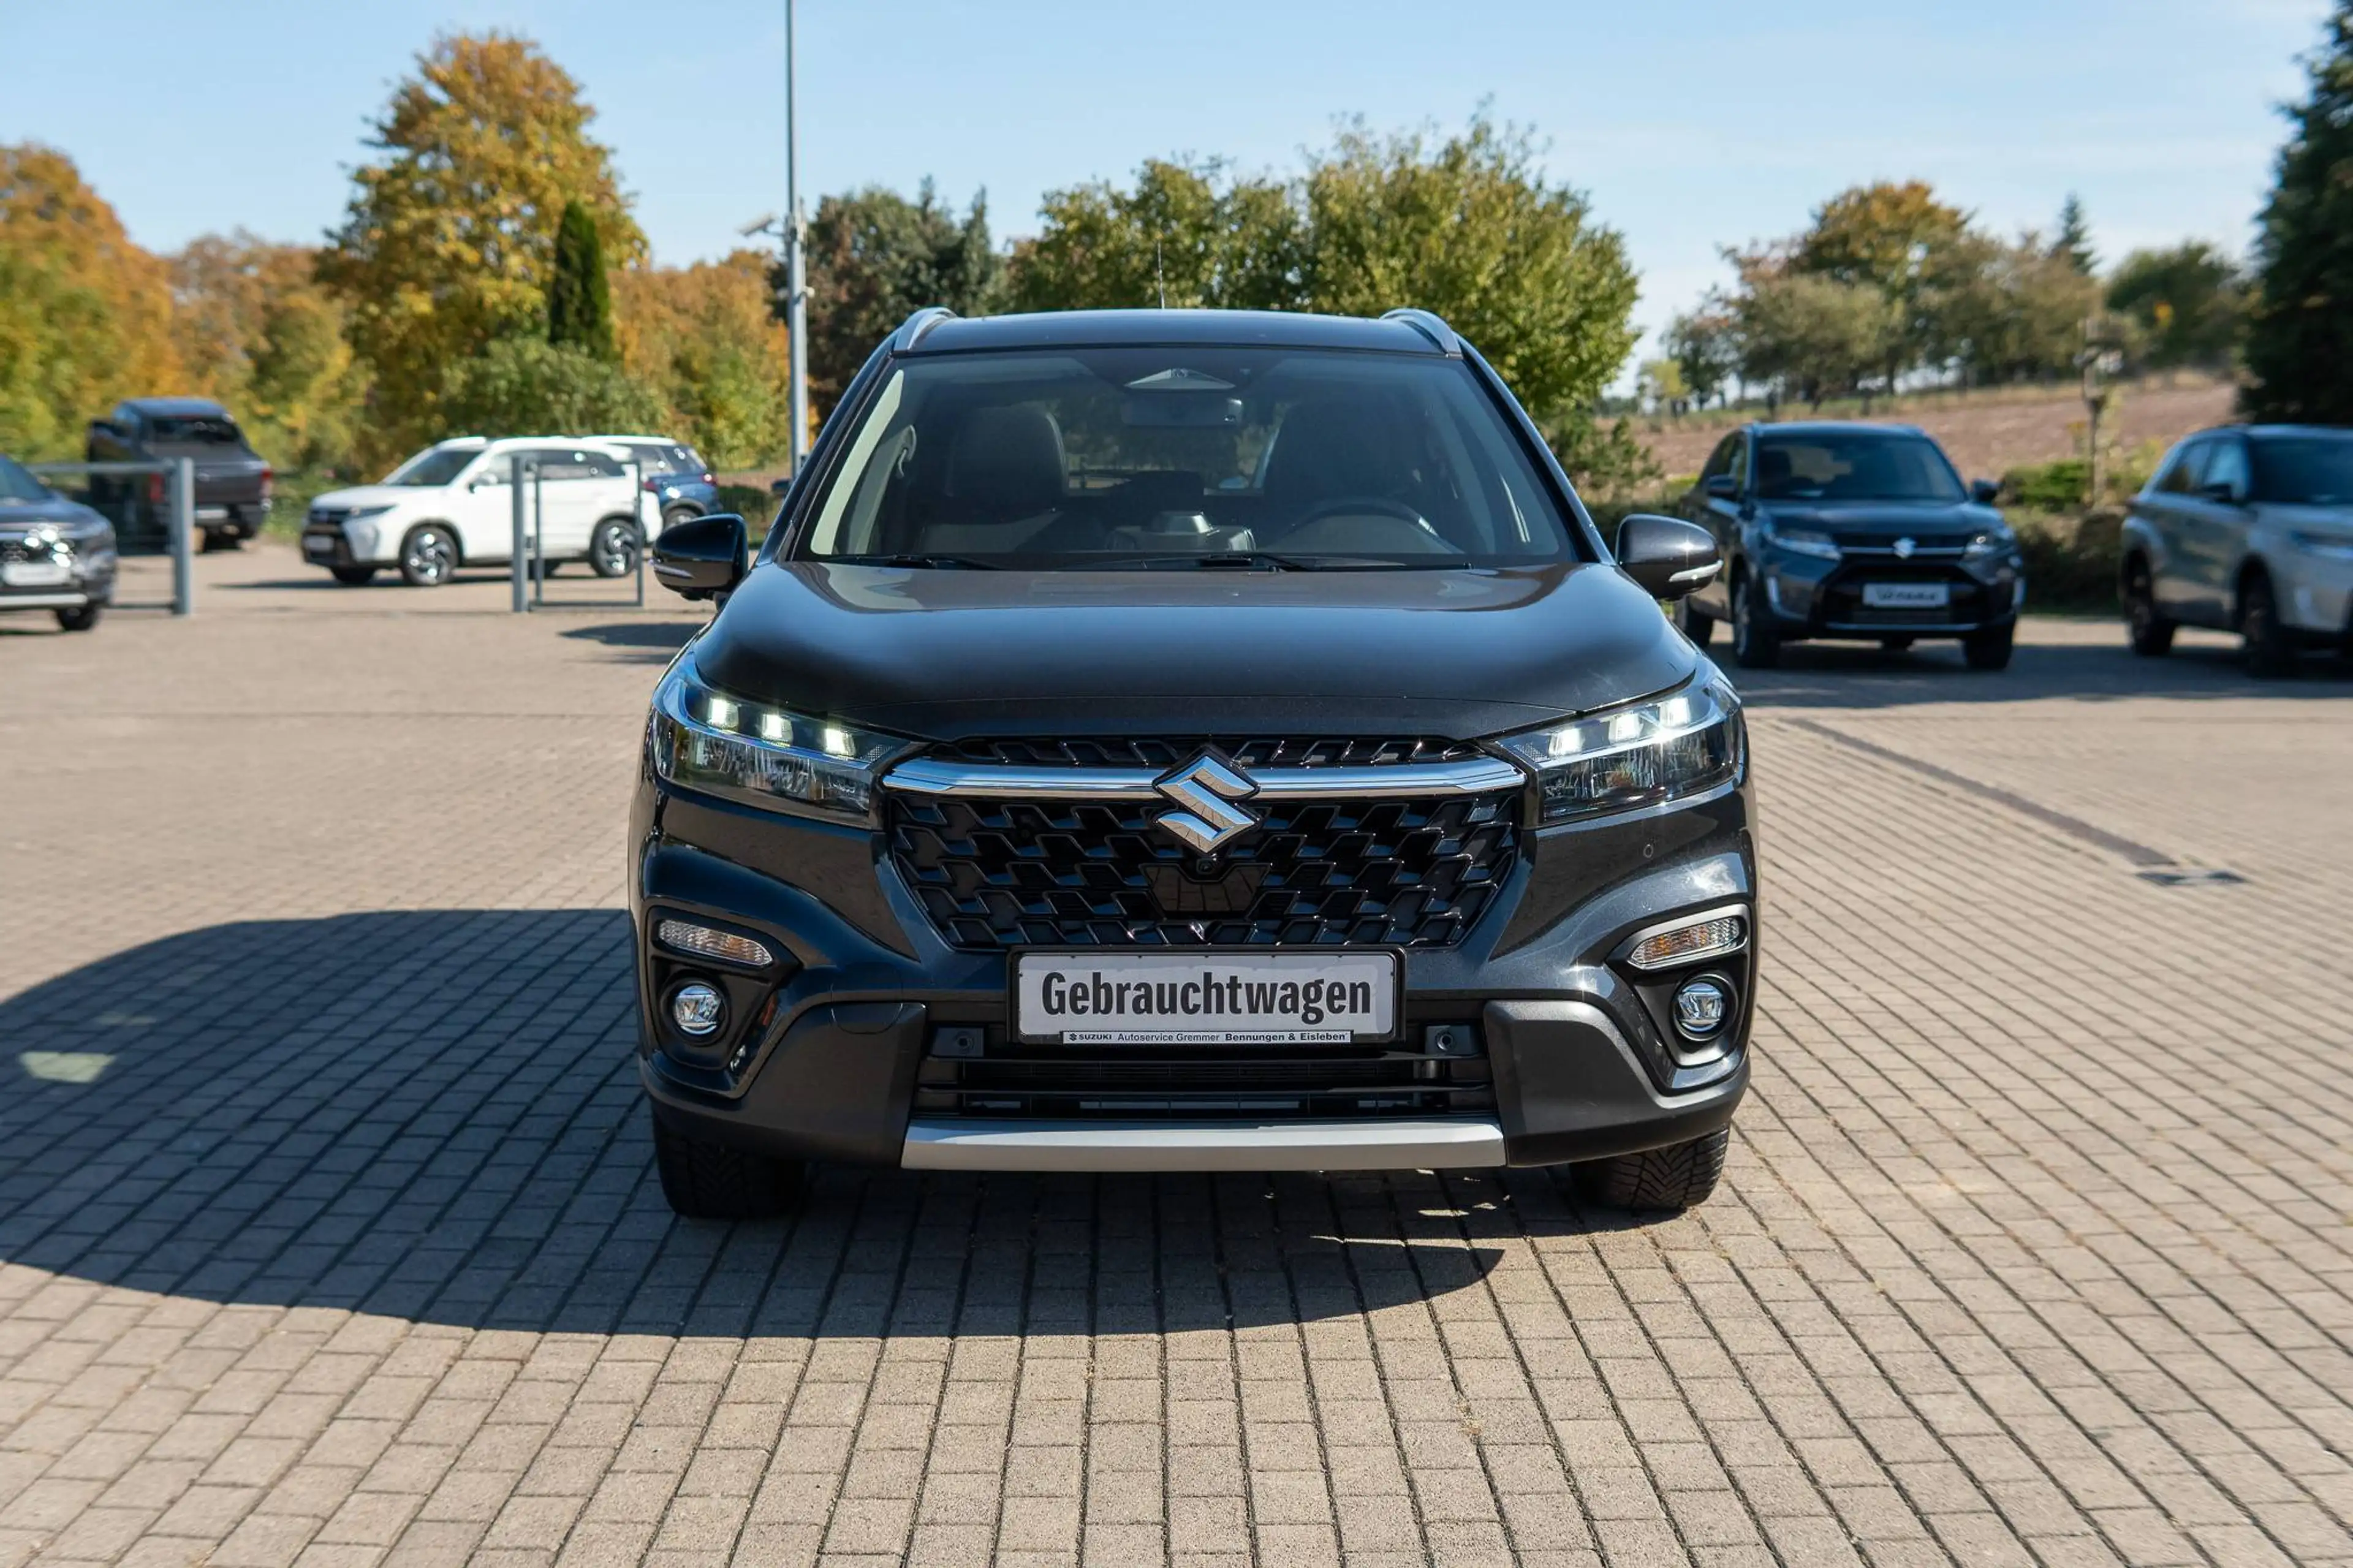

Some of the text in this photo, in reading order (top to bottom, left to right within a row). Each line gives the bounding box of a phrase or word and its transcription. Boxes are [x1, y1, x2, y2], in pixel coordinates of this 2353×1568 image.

[1042, 972, 1371, 1025] Gebrauchtwagen
[1117, 1033, 1173, 1042] Autoservice
[1176, 1033, 1220, 1042] Gremmer
[1225, 1033, 1285, 1042] Bennungen
[1287, 1032, 1296, 1041] &
